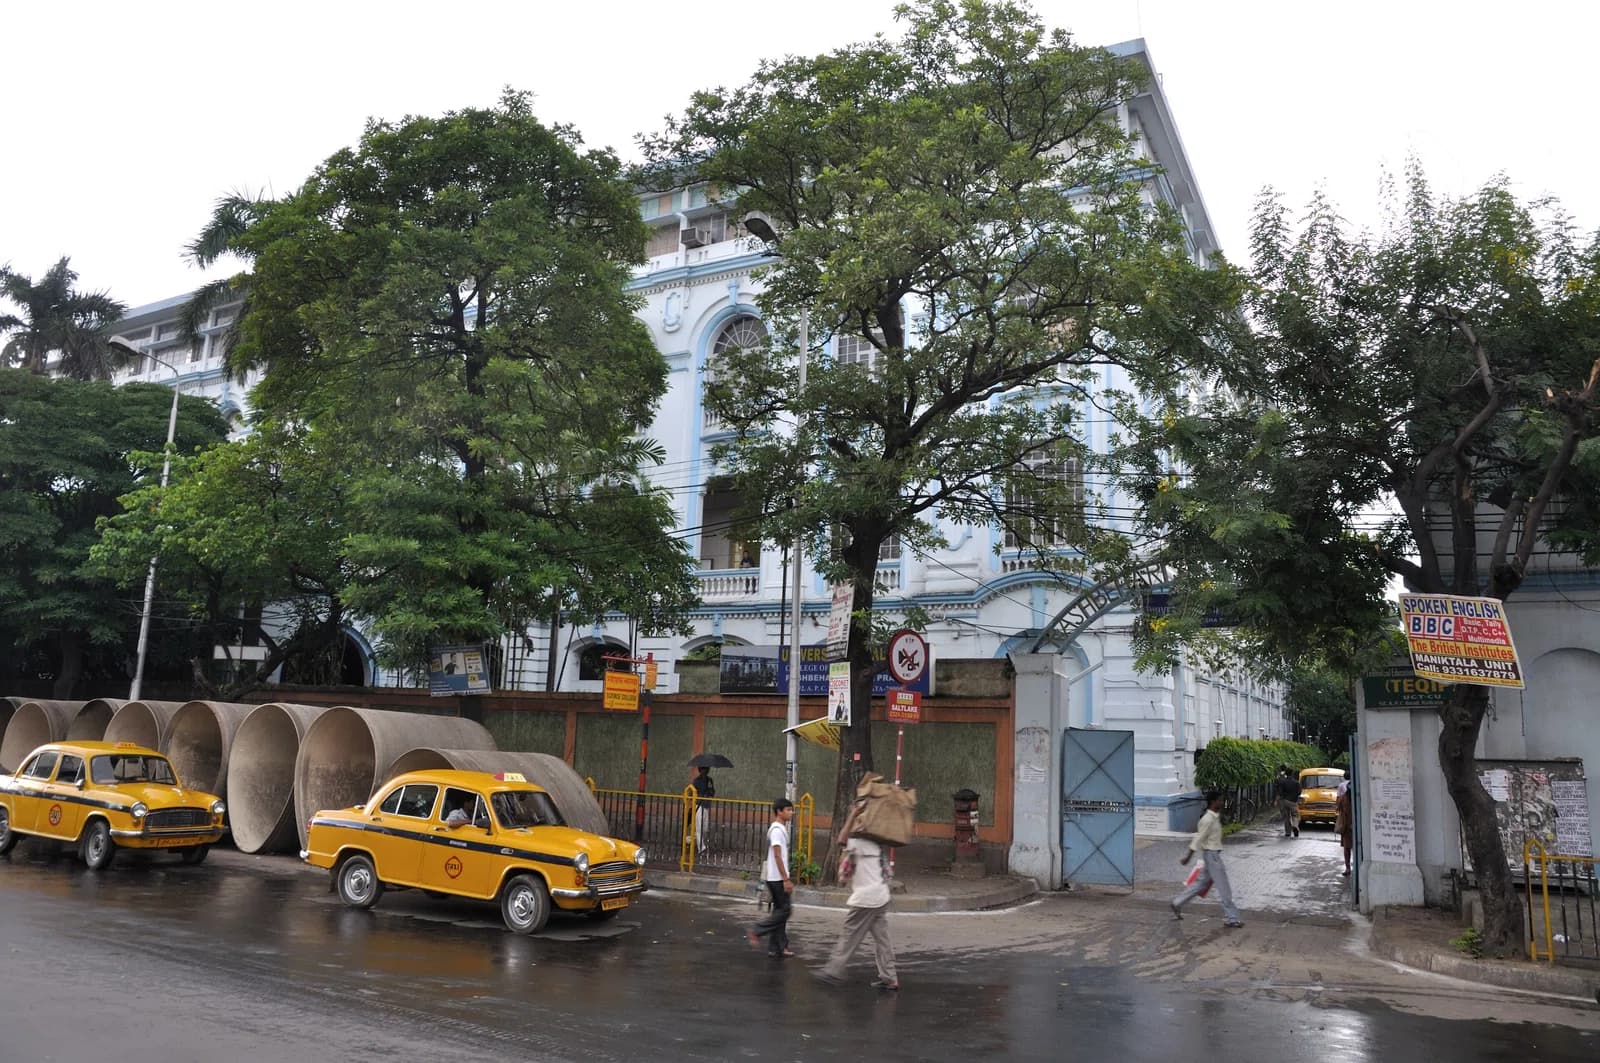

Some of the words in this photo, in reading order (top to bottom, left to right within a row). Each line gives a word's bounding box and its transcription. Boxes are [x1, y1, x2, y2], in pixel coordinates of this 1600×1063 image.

[1404, 598, 1448, 614] SPOKEN
[1451, 600, 1500, 618] ENGLISH
[1411, 617, 1453, 635] BBC
[1491, 628, 1506, 636] C++
[1410, 640, 1427, 652] The
[1430, 641, 1460, 656] British
[1464, 644, 1514, 660] Institutes
[1415, 654, 1478, 668] MANIKTALA
[1484, 660, 1513, 671] UNIT
[1417, 663, 1440, 673] Call:
[1442, 666, 1516, 679] 9331637879
